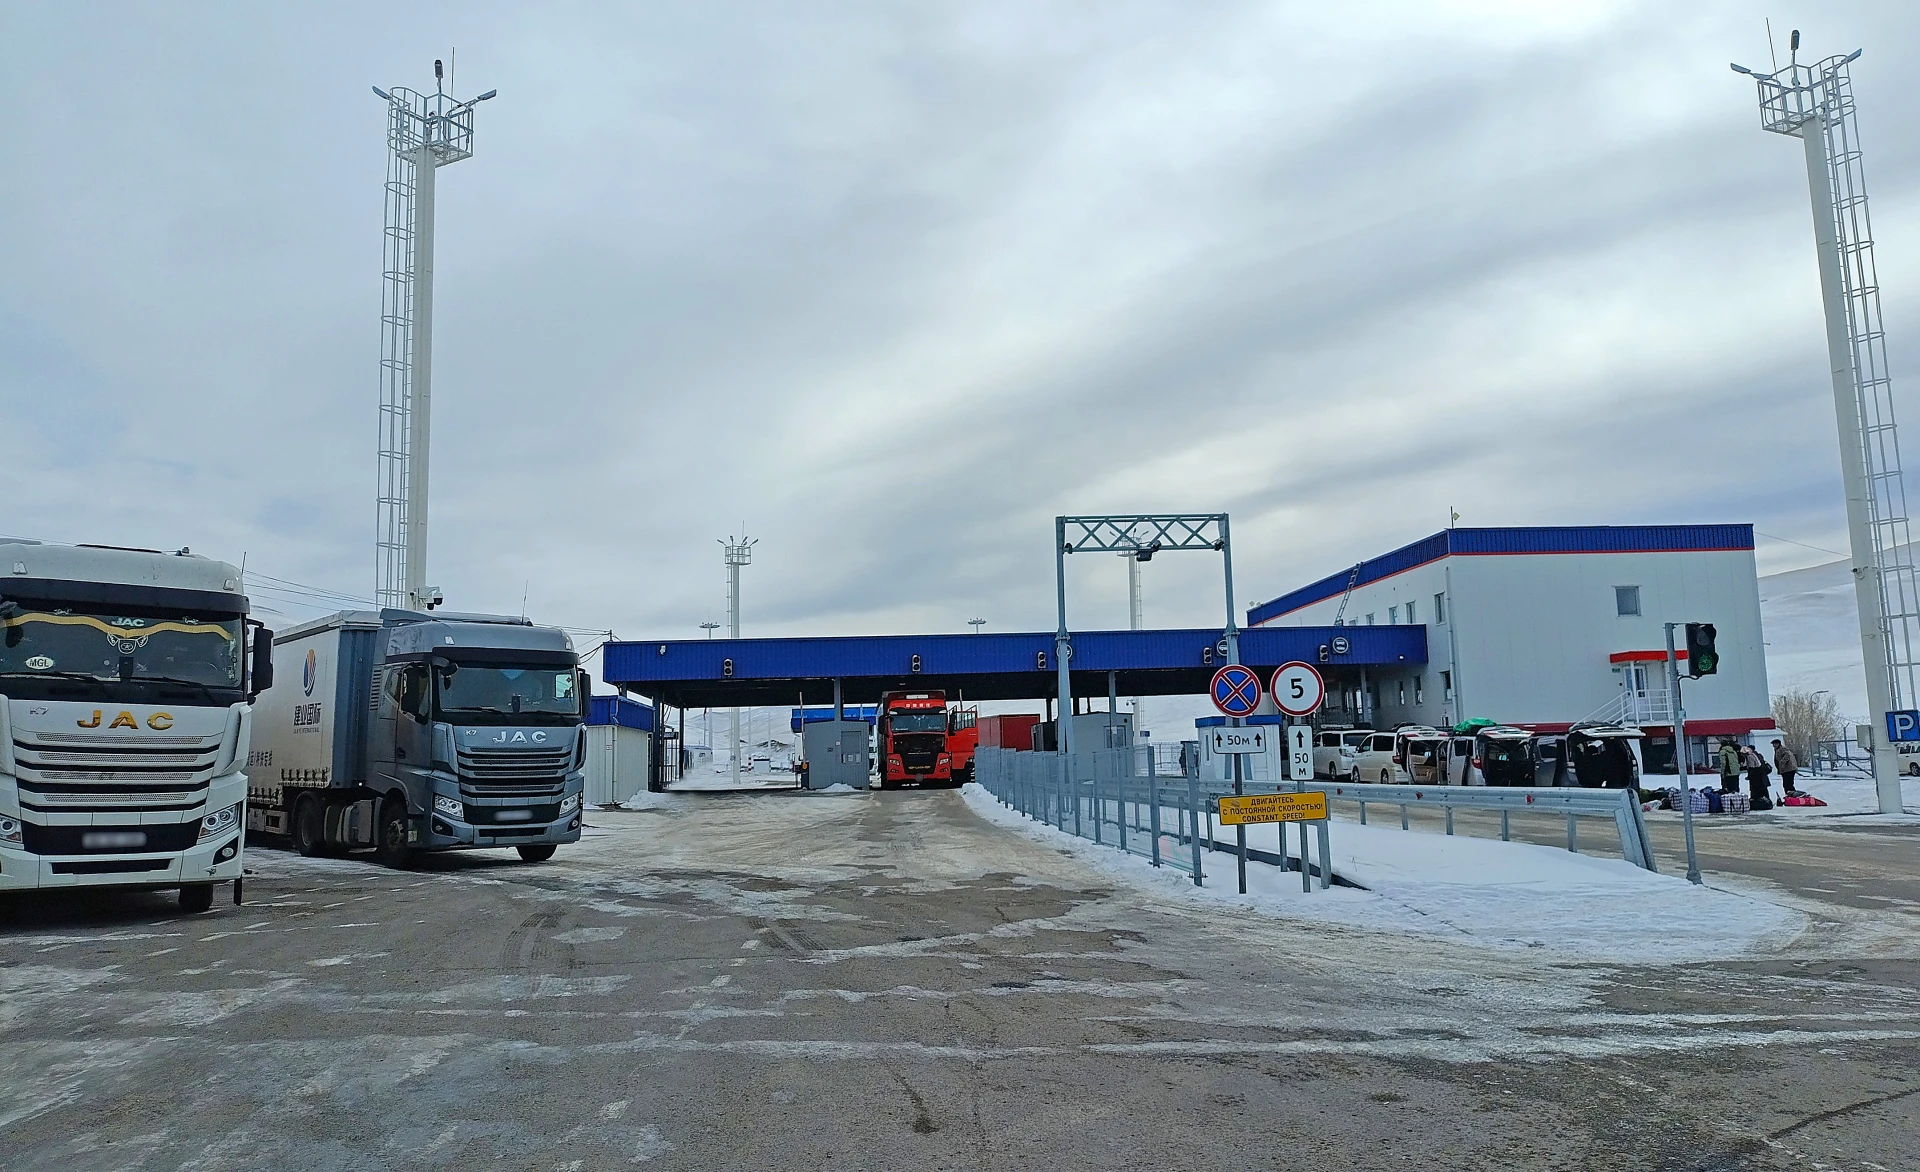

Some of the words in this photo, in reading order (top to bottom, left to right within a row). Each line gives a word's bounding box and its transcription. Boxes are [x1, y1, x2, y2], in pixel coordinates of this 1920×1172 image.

[111, 617, 145, 627] JAC
[29, 658, 50, 668] MGL
[1290, 677, 1304, 699] 5
[29, 706, 49, 715] K7
[76, 709, 174, 731] JAC
[1894, 714, 1915, 739] P
[492, 730, 547, 744] JAC
[1227, 735, 1250, 746] 50м
[1294, 752, 1309, 764] 50
[1250, 795, 1295, 806] ДВИГАЙТЕСЬ
[1222, 808, 1228, 816] С
[1229, 804, 1276, 815] ПОСТОЯННОЙ
[1278, 803, 1324, 812] СКОРОСТЬЮ!
[1241, 814, 1279, 823] CONSTANT
[1281, 812, 1306, 820] SPEED!
